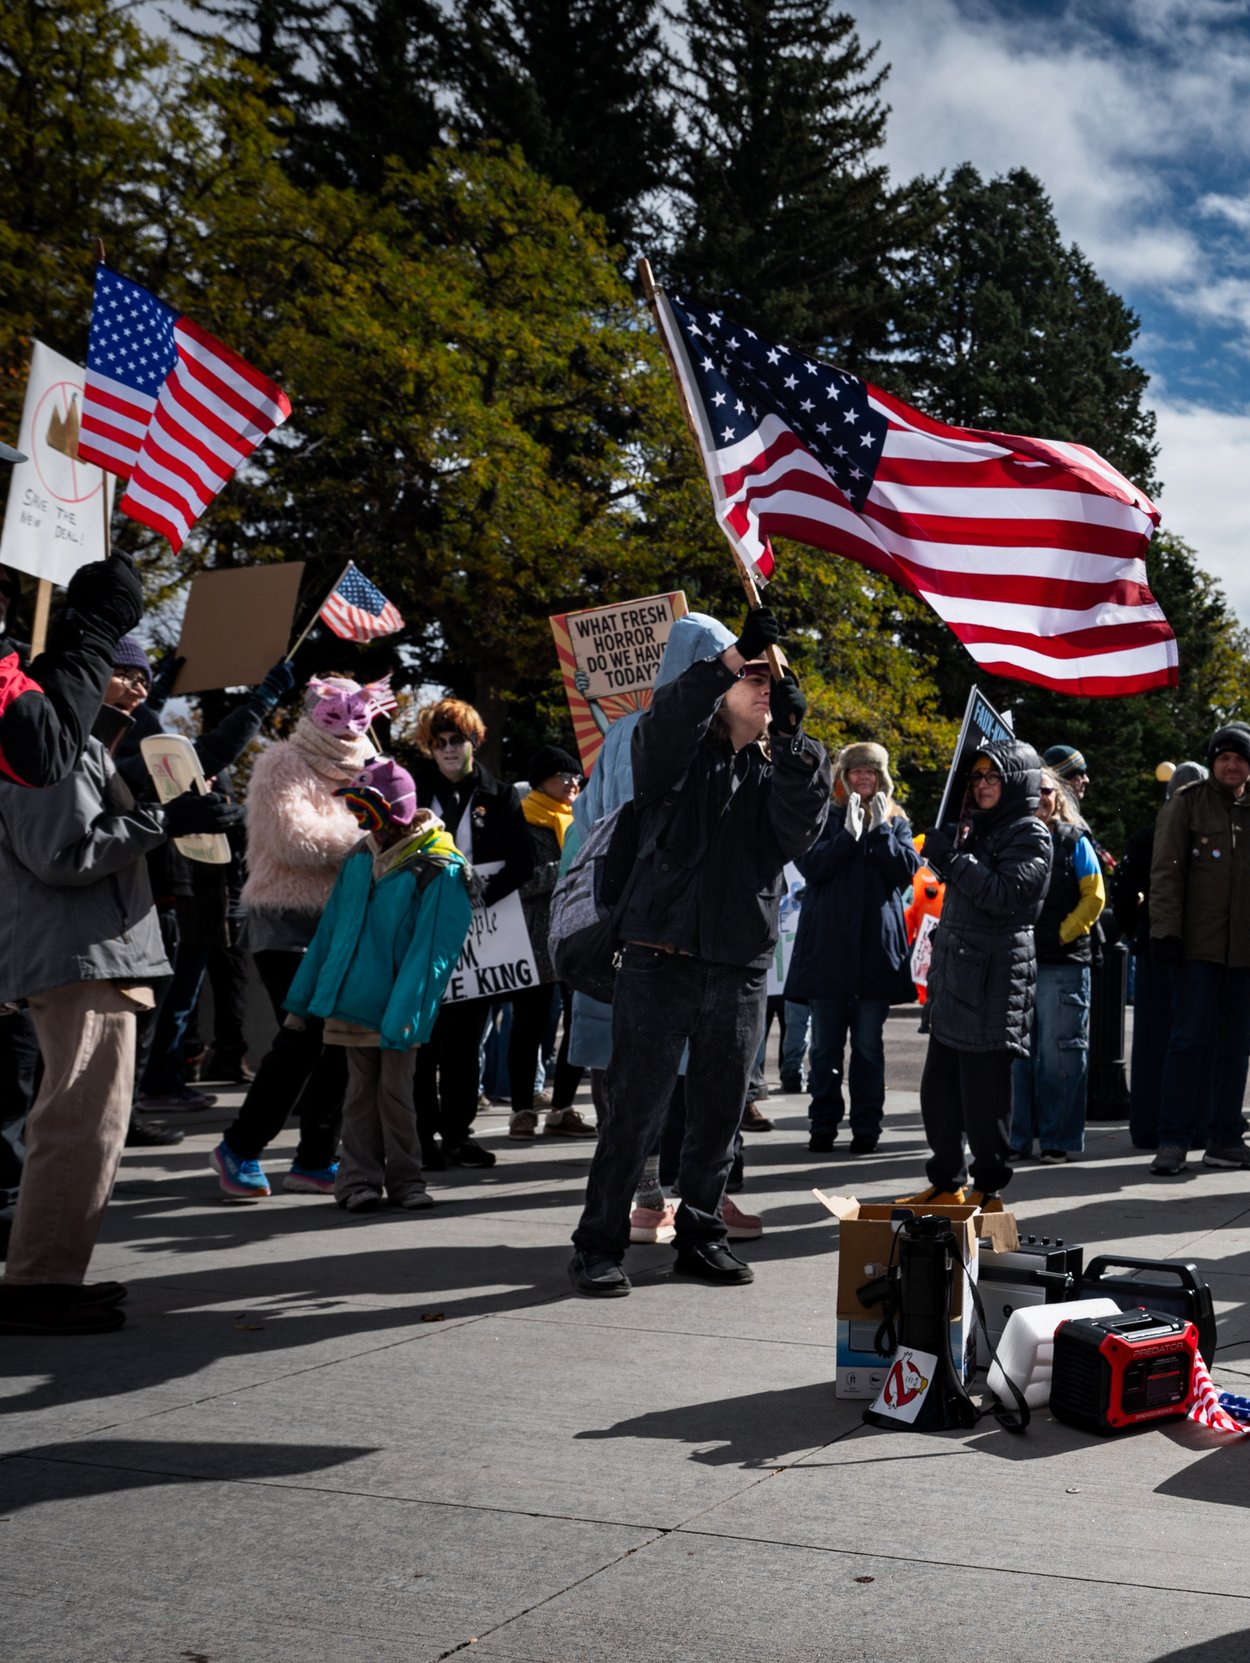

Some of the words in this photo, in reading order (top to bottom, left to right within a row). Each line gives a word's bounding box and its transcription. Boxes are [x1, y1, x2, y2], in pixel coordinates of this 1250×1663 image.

[19, 510, 42, 528] NEW
[22, 488, 49, 513] SAVE
[55, 506, 77, 526] THE
[574, 613, 619, 638] WHAT
[620, 604, 668, 629] FRESH
[593, 626, 656, 654] HORROR
[587, 656, 607, 673] DO
[609, 650, 633, 669] WE
[474, 958, 533, 995] KING
[1132, 1341, 1184, 1358] PREDATOR
